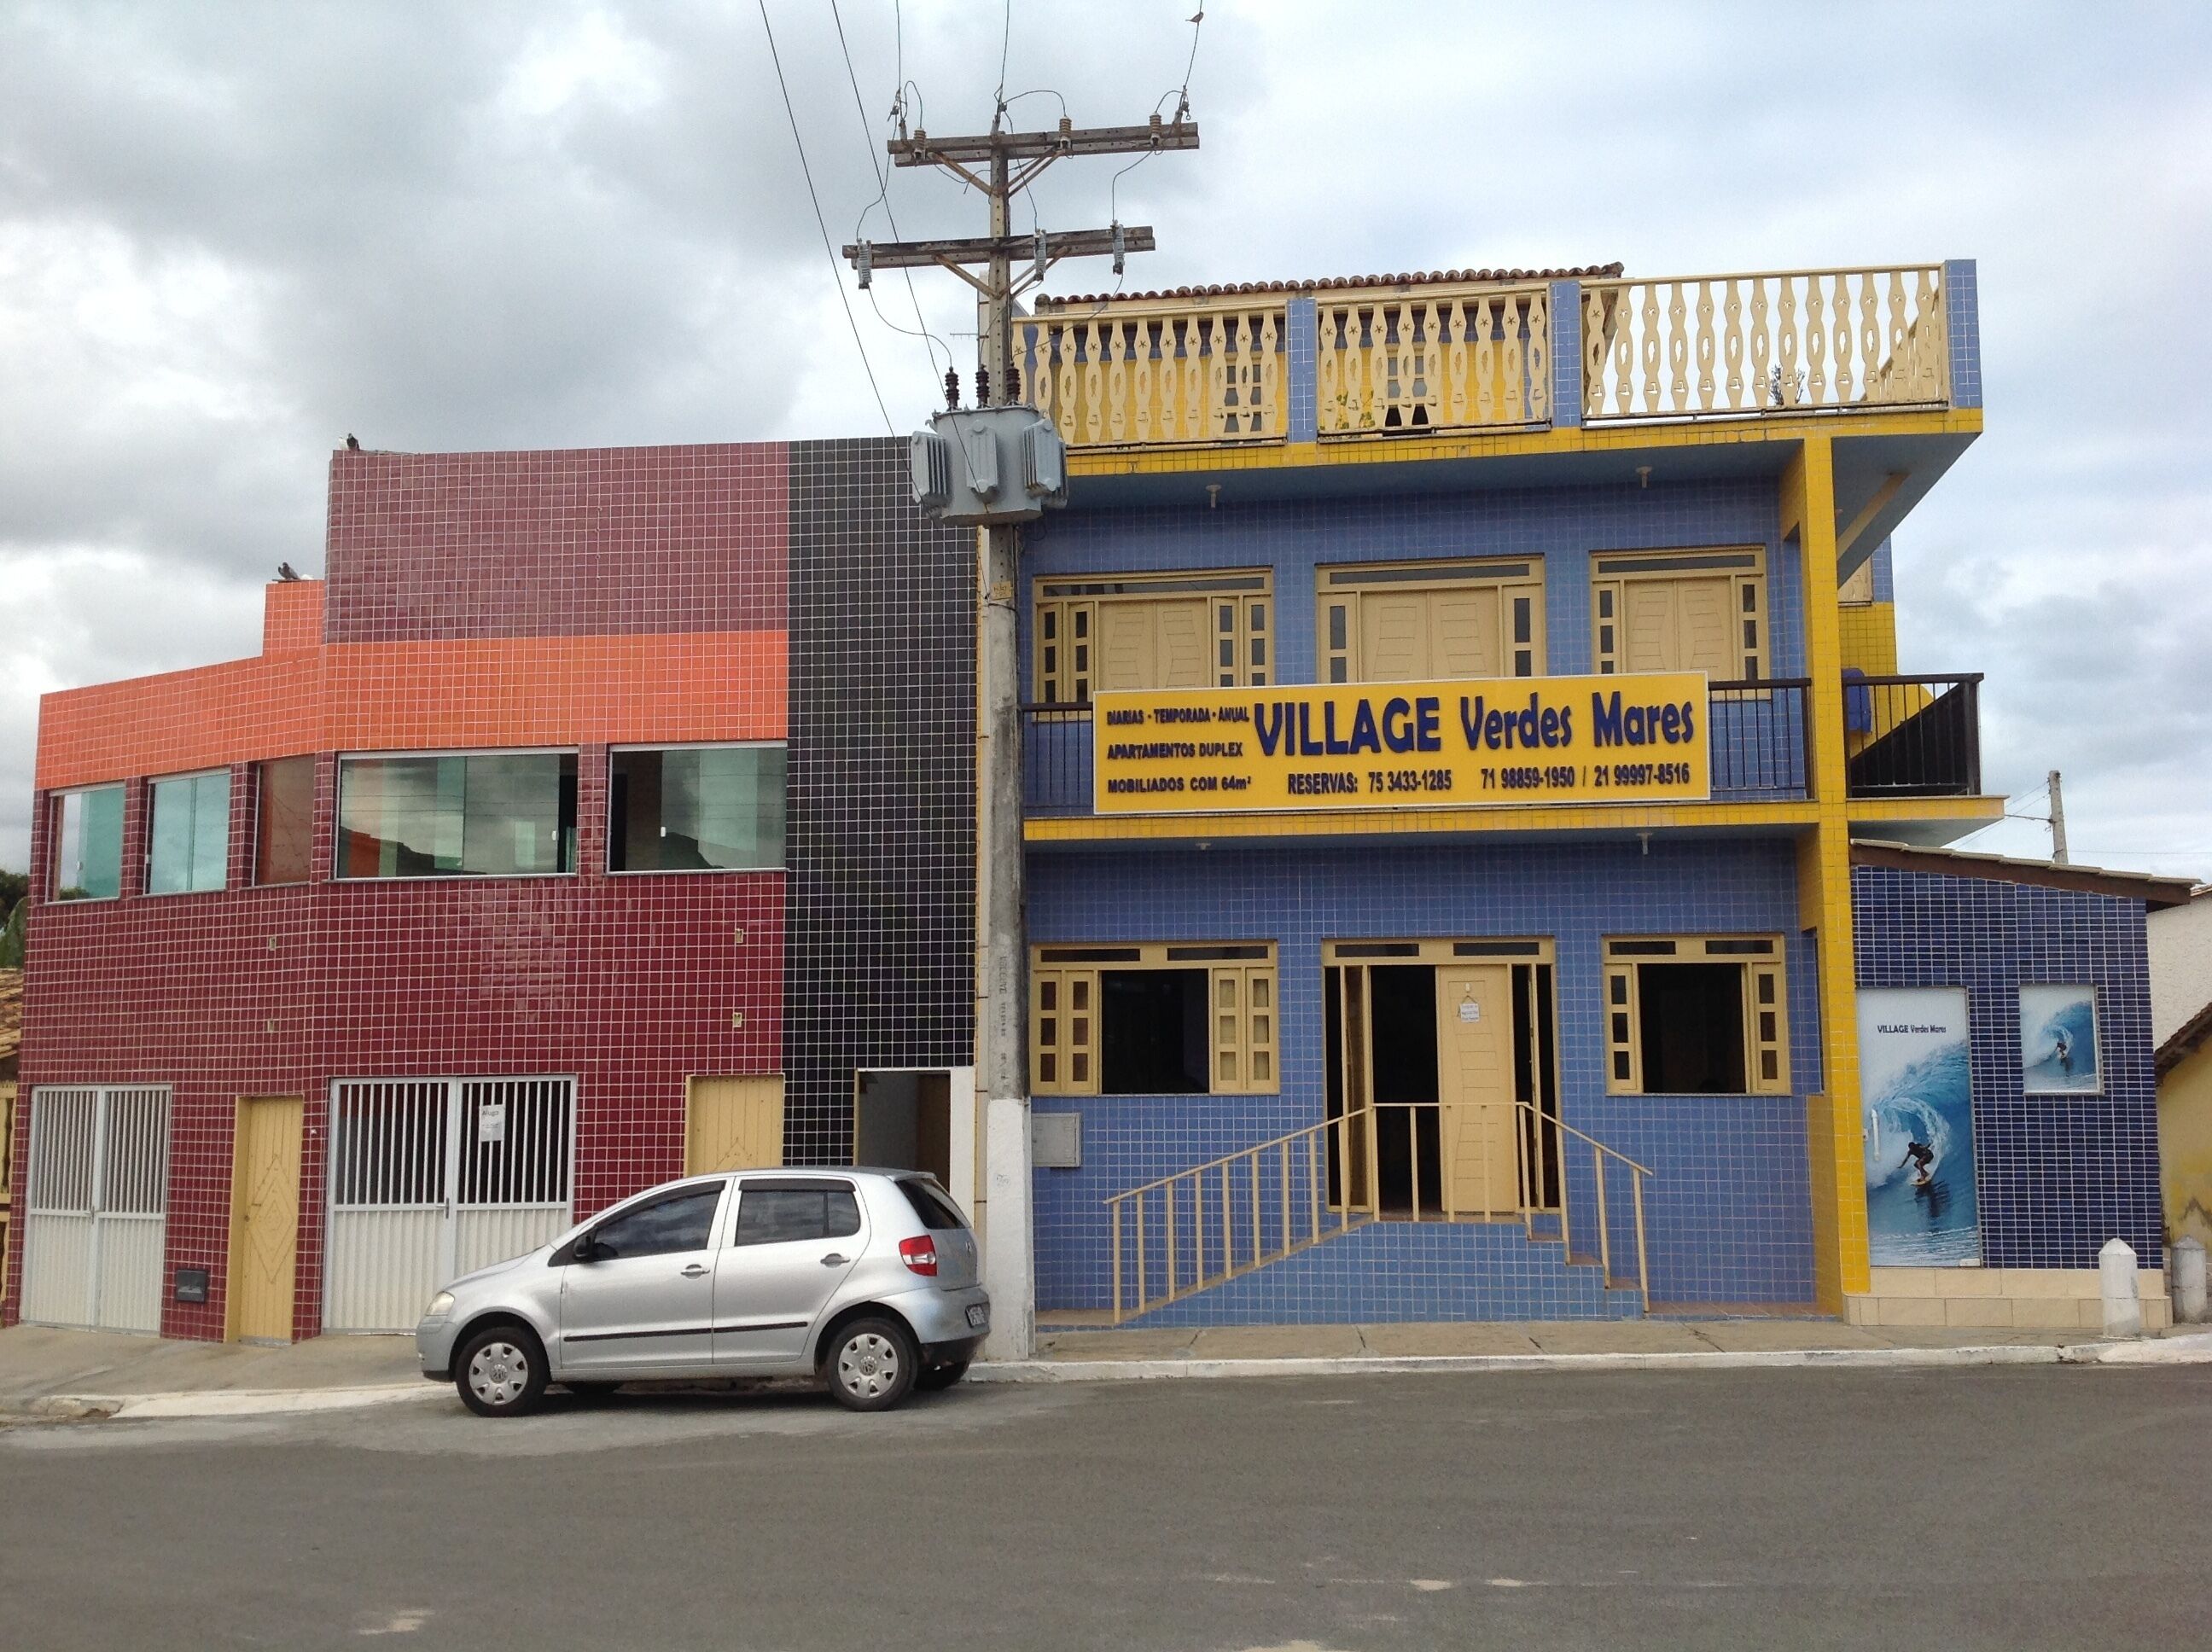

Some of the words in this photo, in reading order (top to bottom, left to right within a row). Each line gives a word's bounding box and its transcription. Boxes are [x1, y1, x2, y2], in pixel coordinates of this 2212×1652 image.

[1154, 707, 1211, 724] TEMPORADA
[1218, 706, 1250, 723] ANUAL
[1254, 697, 1441, 756] VILLAGE
[1460, 691, 1573, 750] Verdes
[1591, 690, 1695, 747] Mares
[1107, 742, 1196, 759] APARTAMENTOS
[1199, 742, 1243, 758] DUPLEX
[1107, 777, 1185, 794] MOBILIADOS
[1190, 776, 1218, 792] COM
[1287, 771, 1358, 794] RESERVAS:
[1368, 771, 1383, 793] 75
[1387, 769, 1452, 792] 3433-1285
[1481, 767, 1495, 789] 71
[1500, 765, 1575, 789] 98859-1950
[1593, 765, 1609, 787] 21
[1613, 762, 1690, 786] 99997-8516
[1877, 1025, 1909, 1033] VILLAGE
